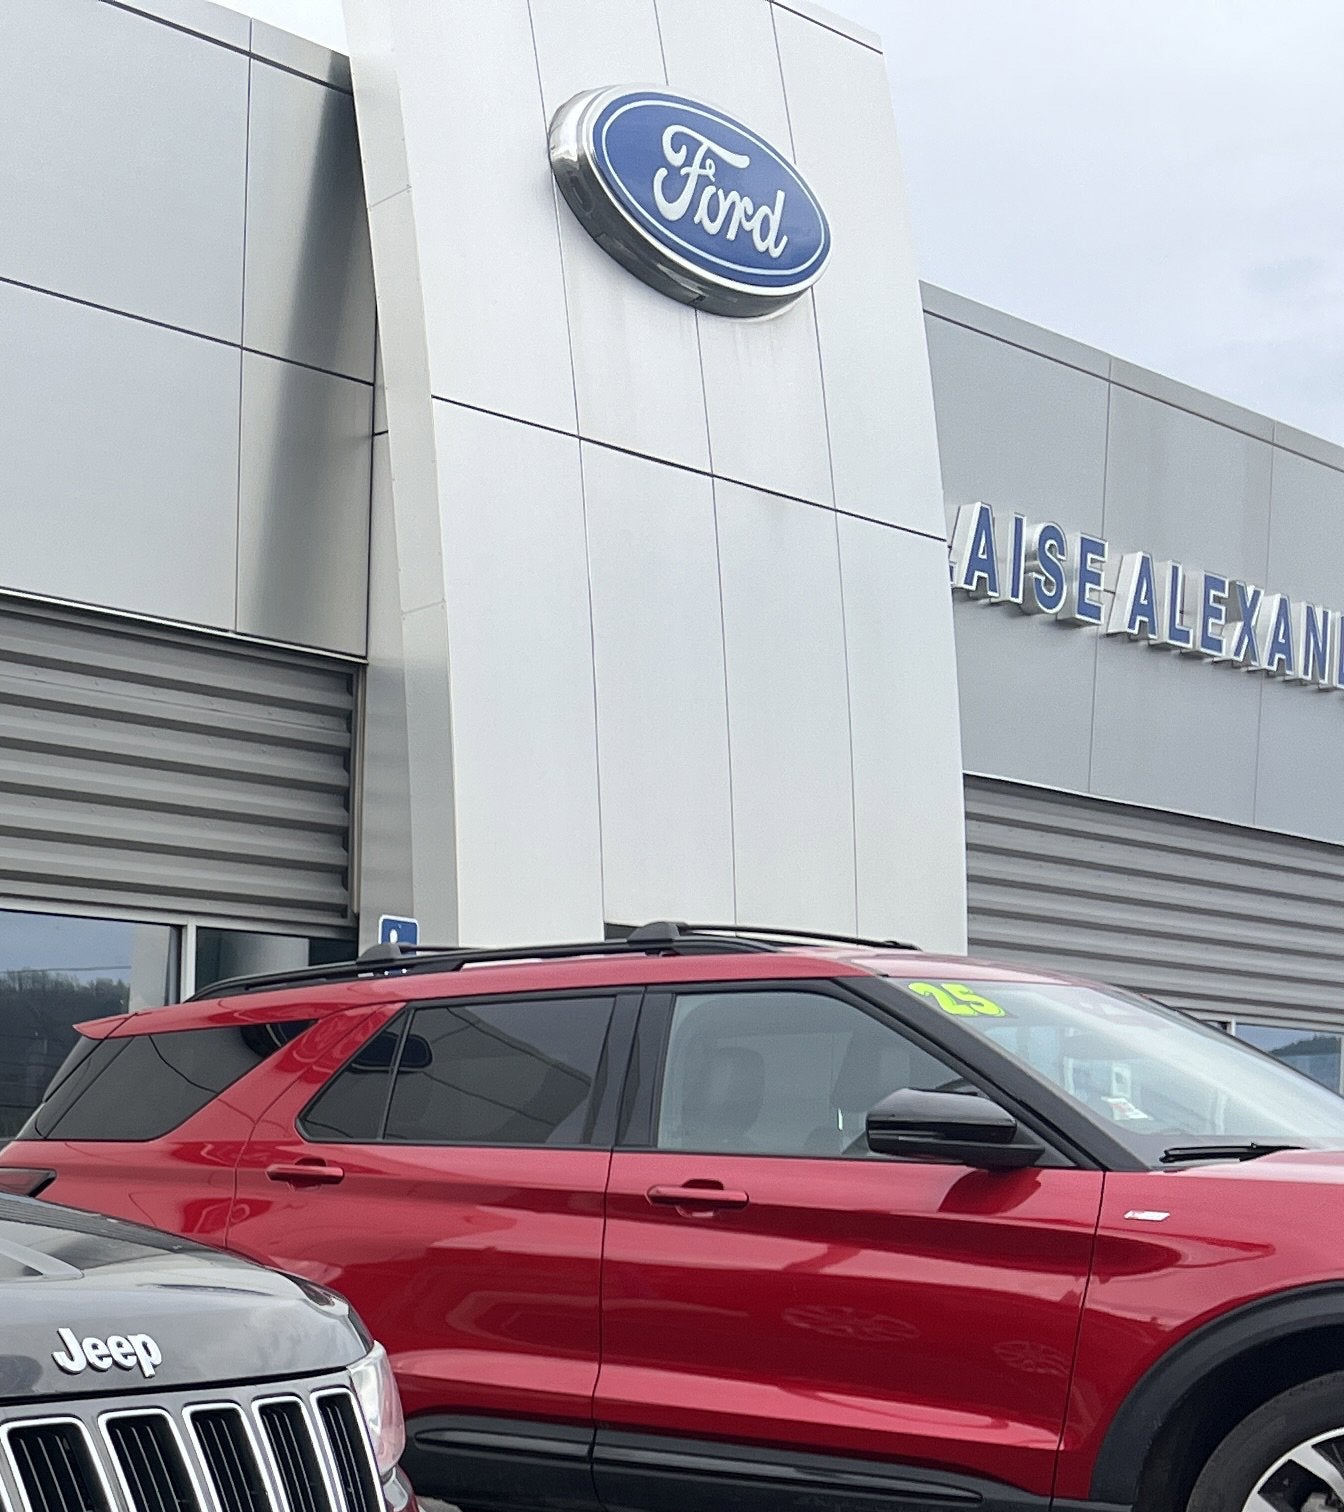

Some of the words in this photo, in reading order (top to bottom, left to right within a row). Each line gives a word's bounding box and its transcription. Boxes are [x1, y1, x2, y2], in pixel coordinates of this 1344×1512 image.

[653, 124, 788, 259] Ford
[949, 500, 1108, 626] AISE
[909, 981, 1008, 1017] 25
[51, 1327, 162, 1378] Jeep
